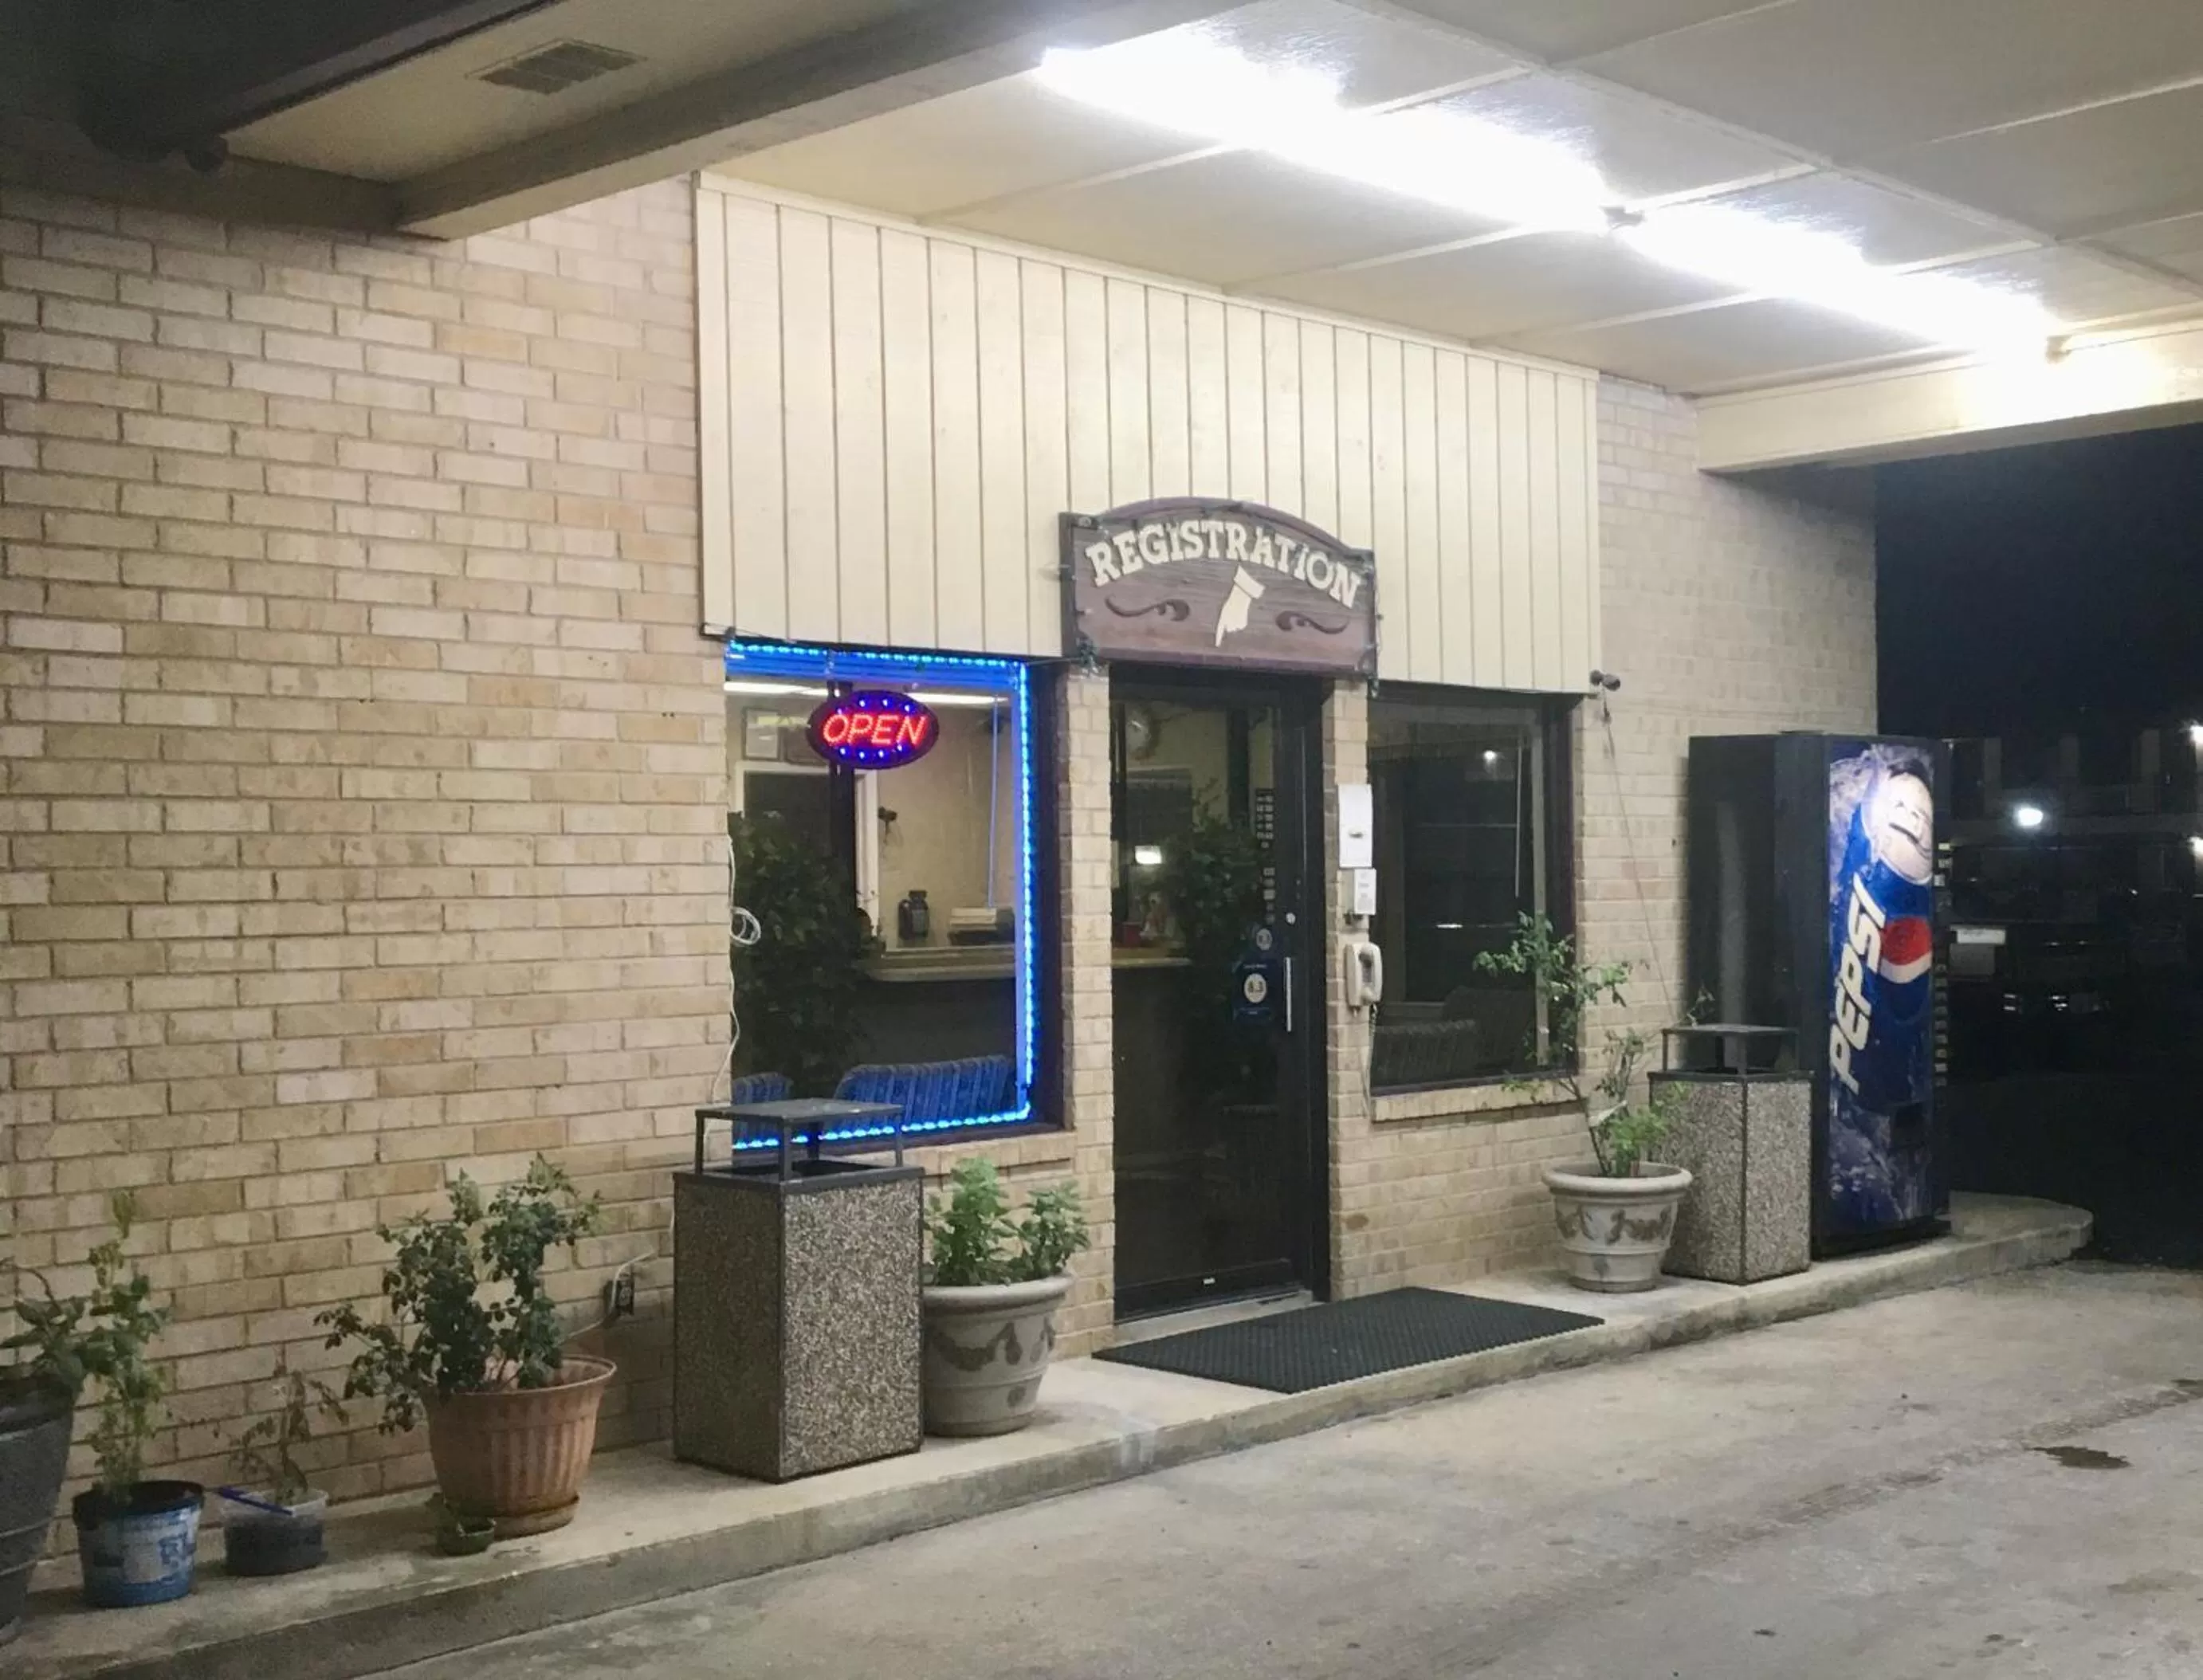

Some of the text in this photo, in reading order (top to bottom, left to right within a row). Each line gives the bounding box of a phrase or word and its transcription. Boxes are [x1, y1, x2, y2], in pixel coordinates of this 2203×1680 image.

[1085, 519, 1361, 609] REGISTRATION
[823, 713, 929, 748] OPEN
[1830, 872, 1886, 1095] PEPSI
